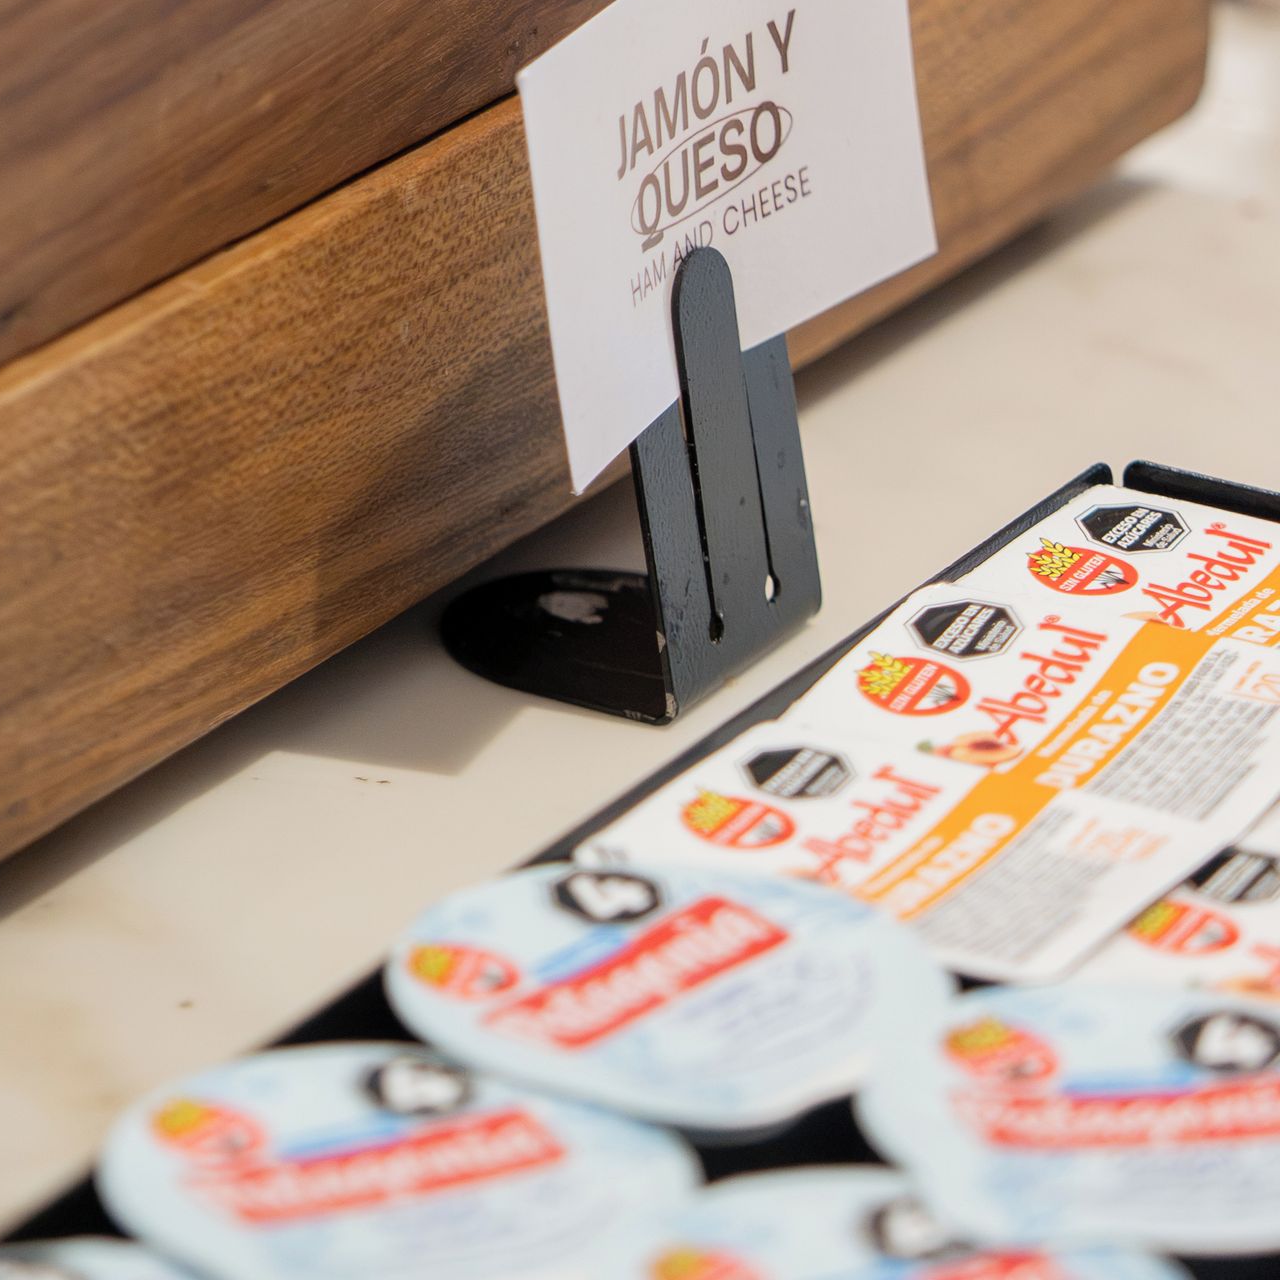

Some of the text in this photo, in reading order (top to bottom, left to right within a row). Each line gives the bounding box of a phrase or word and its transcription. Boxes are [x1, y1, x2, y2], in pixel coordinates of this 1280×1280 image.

[617, 8, 796, 181] JAMÓN Y
[637, 101, 782, 254] QUESO
[630, 251, 667, 308] HAM
[723, 166, 812, 235] CHEESE
[1101, 507, 1151, 544] EXCESO EN
[1059, 555, 1107, 591] SIN GLUTEN
[907, 662, 939, 696] GLUTEN
